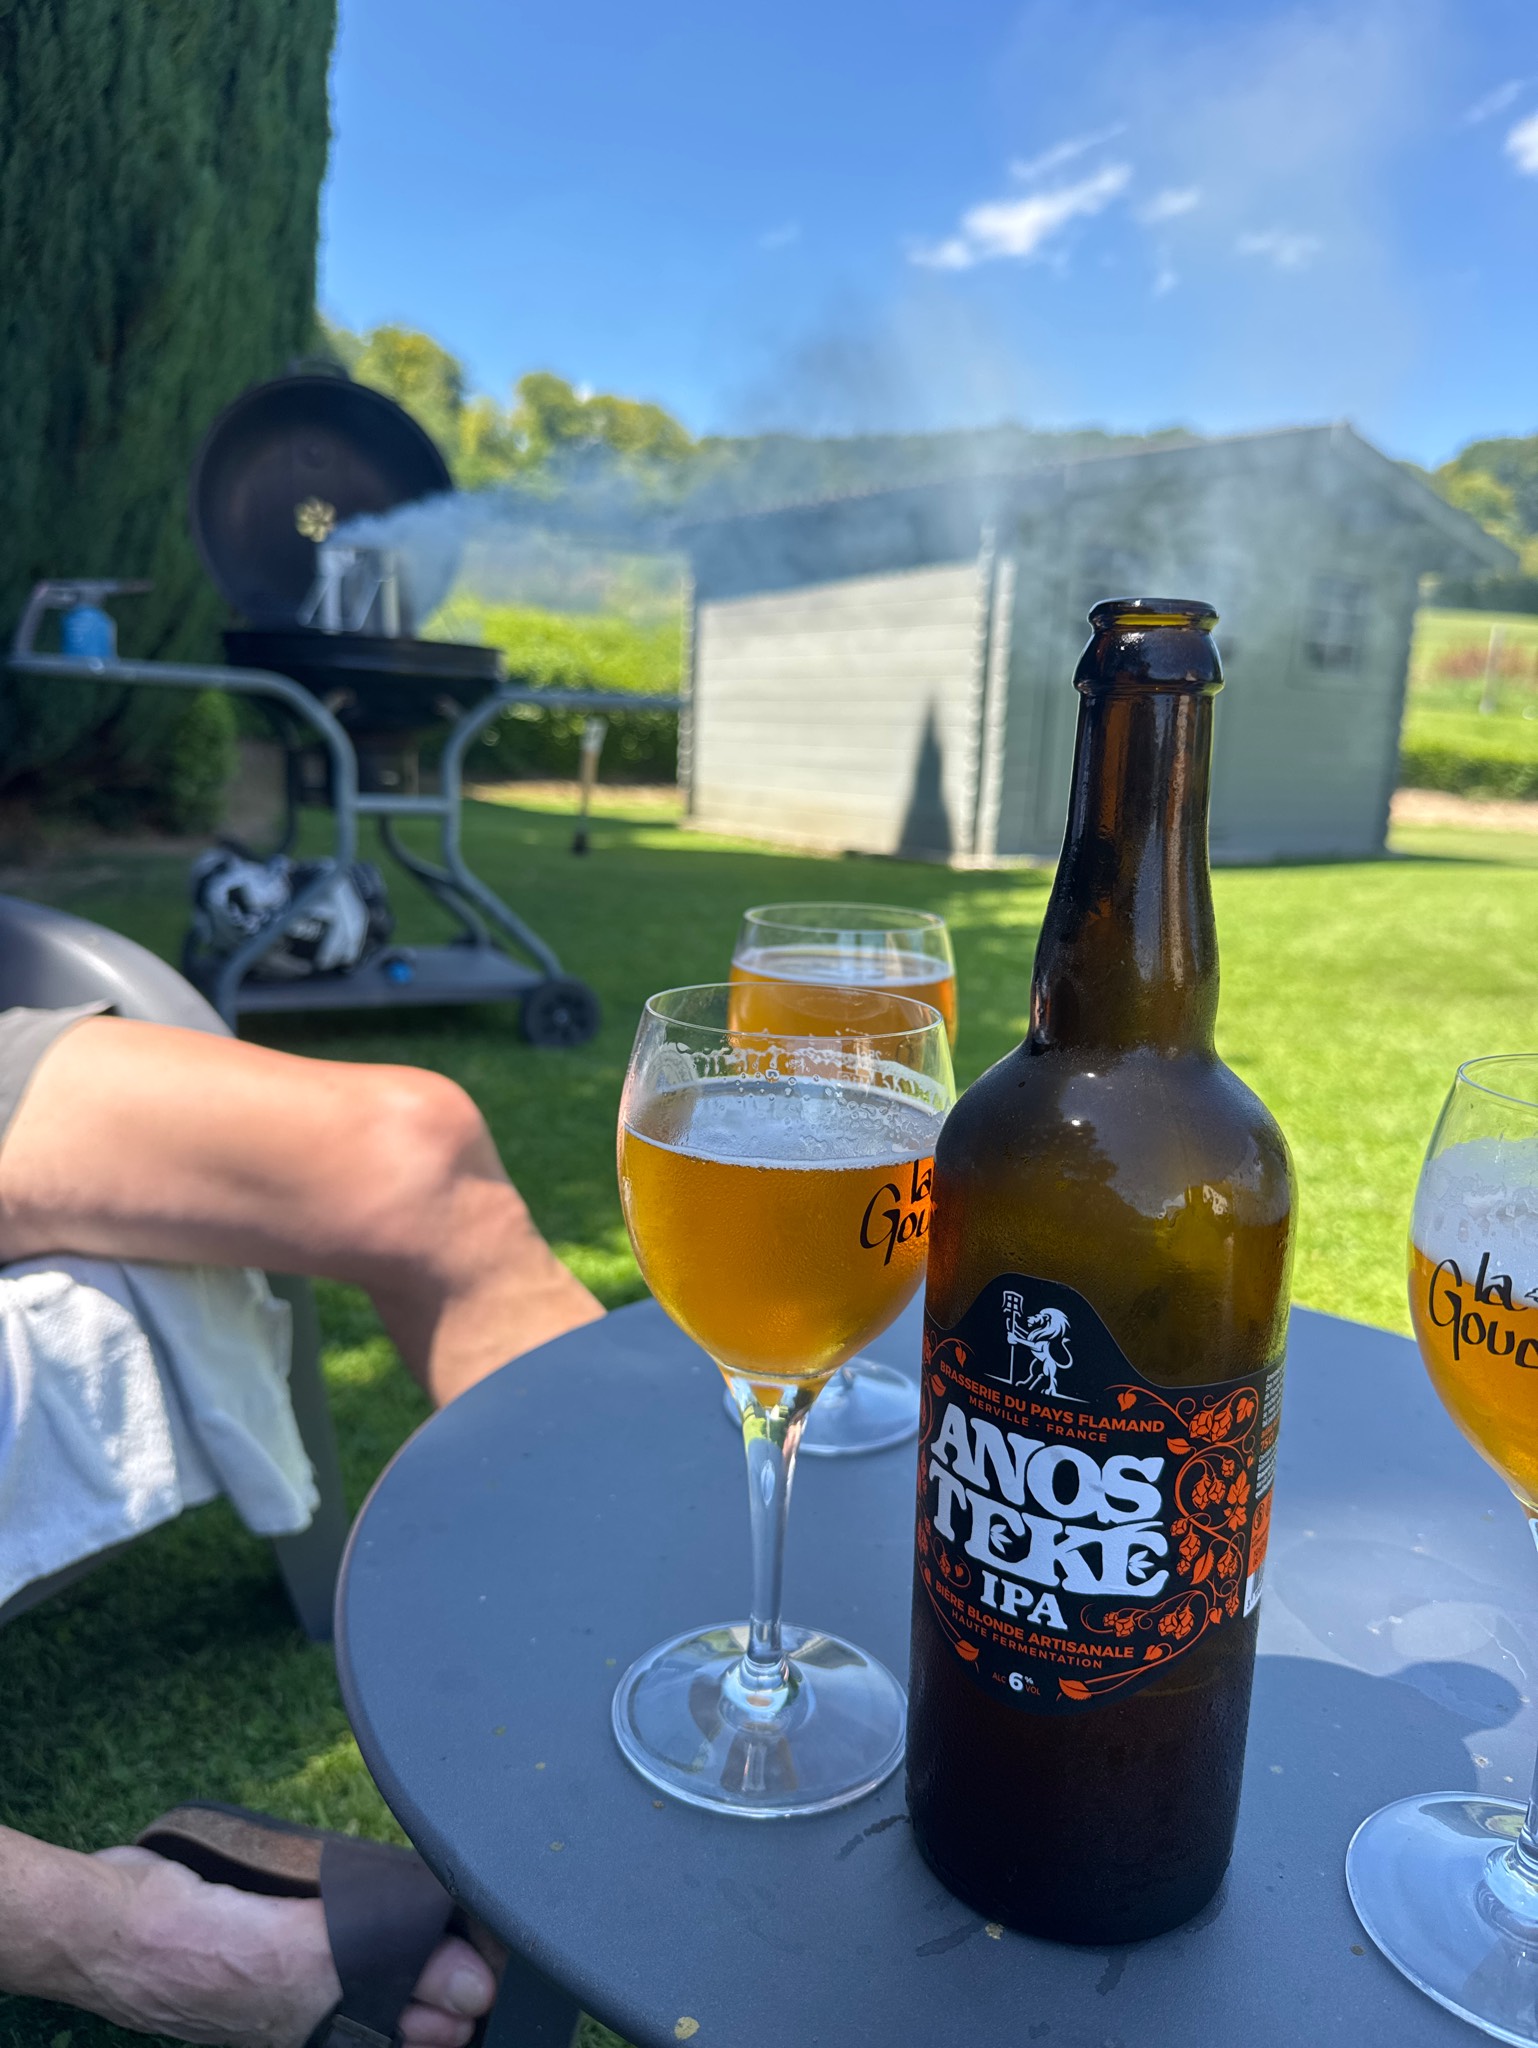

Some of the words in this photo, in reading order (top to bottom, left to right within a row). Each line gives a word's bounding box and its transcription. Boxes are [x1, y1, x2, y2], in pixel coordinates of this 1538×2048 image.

[1474, 1252, 1528, 1311] la
[940, 1360, 1000, 1403] BRASSERIE
[1005, 1396, 1026, 1412] DU
[1030, 1403, 1074, 1424] PAYS
[1078, 1414, 1165, 1433] FLAMAND
[969, 1396, 1029, 1427] MERVILLE
[1047, 1423, 1108, 1443] FRANCE
[930, 1402, 1164, 1524] ANOS
[935, 1580, 965, 1610] BIÈRE
[967, 1604, 1025, 1640] BLONDE
[1028, 1632, 1135, 1659] ARTISANALE
[980, 1569, 1069, 1631] IPA
[952, 1610, 987, 1638] HAUTE
[992, 1633, 1103, 1669] FERMENTATION
[992, 1671, 1006, 1684] ALC
[1025, 1684, 1041, 1696] VOL
